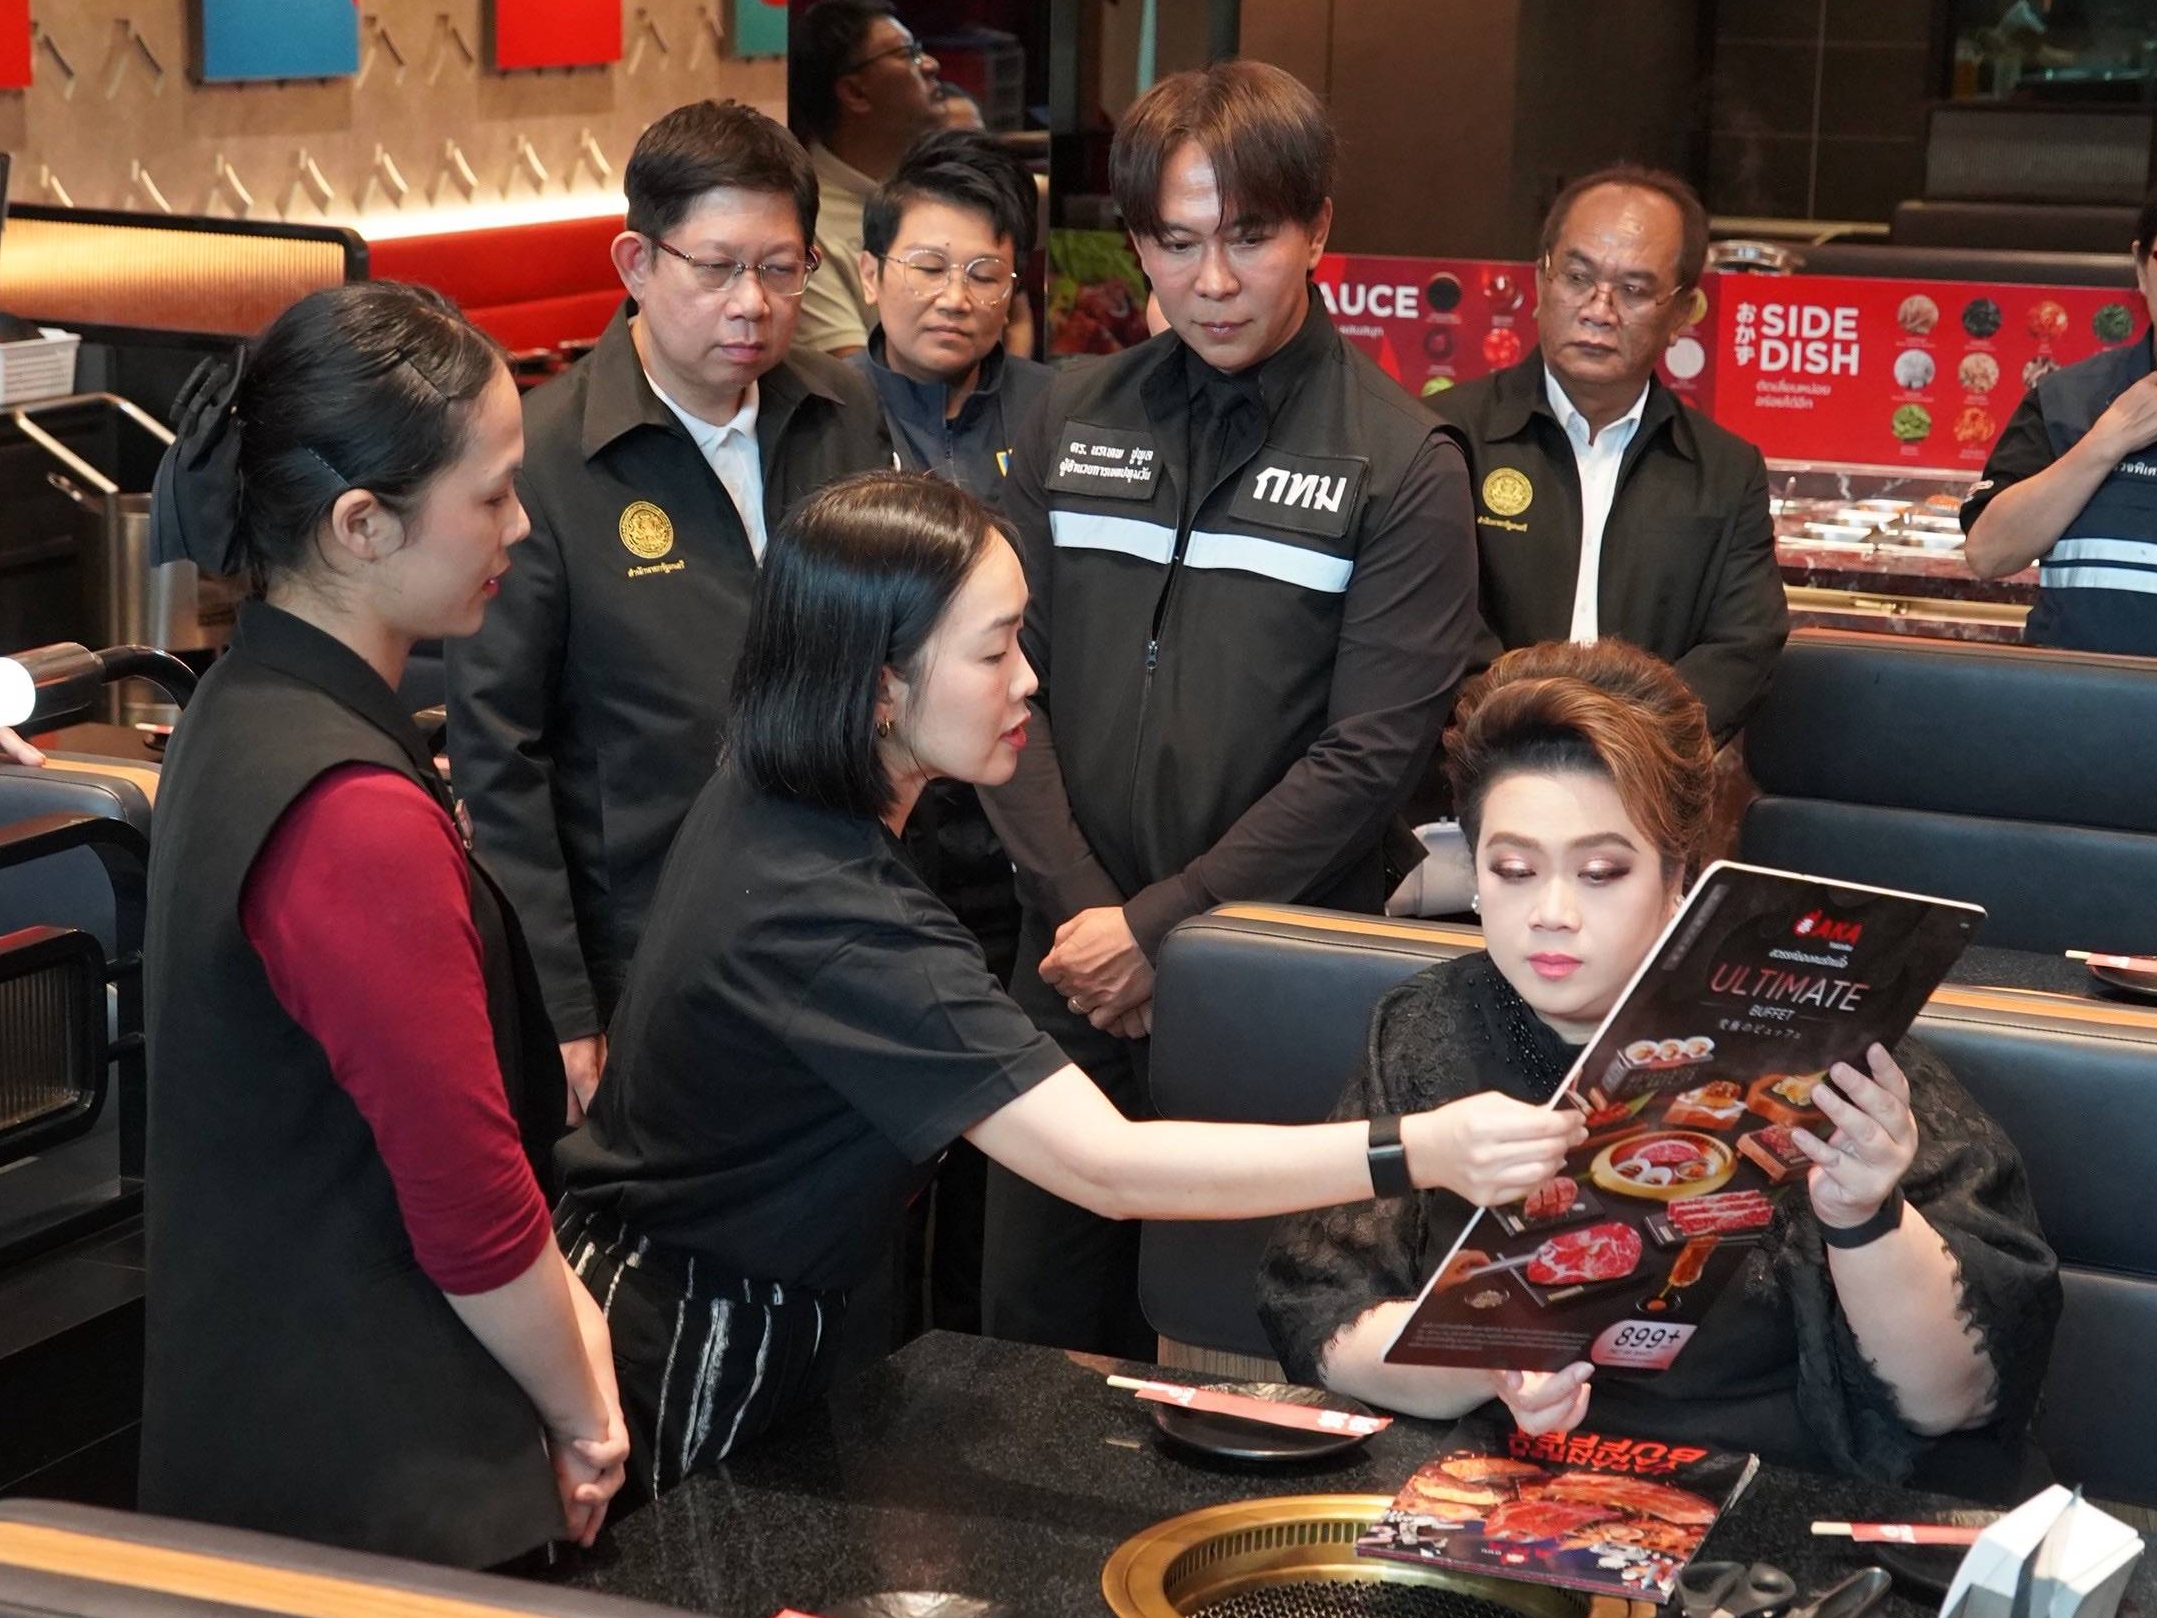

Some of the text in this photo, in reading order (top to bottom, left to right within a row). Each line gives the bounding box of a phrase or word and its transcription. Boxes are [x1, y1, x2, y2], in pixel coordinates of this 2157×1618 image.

[1318, 282, 1419, 318] AUCE
[1735, 302, 1757, 366] おかず
[1760, 303, 1859, 341] SIDE
[1759, 338, 1860, 376] DISH
[1253, 467, 1347, 512] กทม
[1815, 919, 1864, 946] AKA
[1710, 963, 1870, 1012] ULTIMATE
[1748, 1004, 1795, 1022] BUFFET
[1614, 1325, 1681, 1350] 899+
